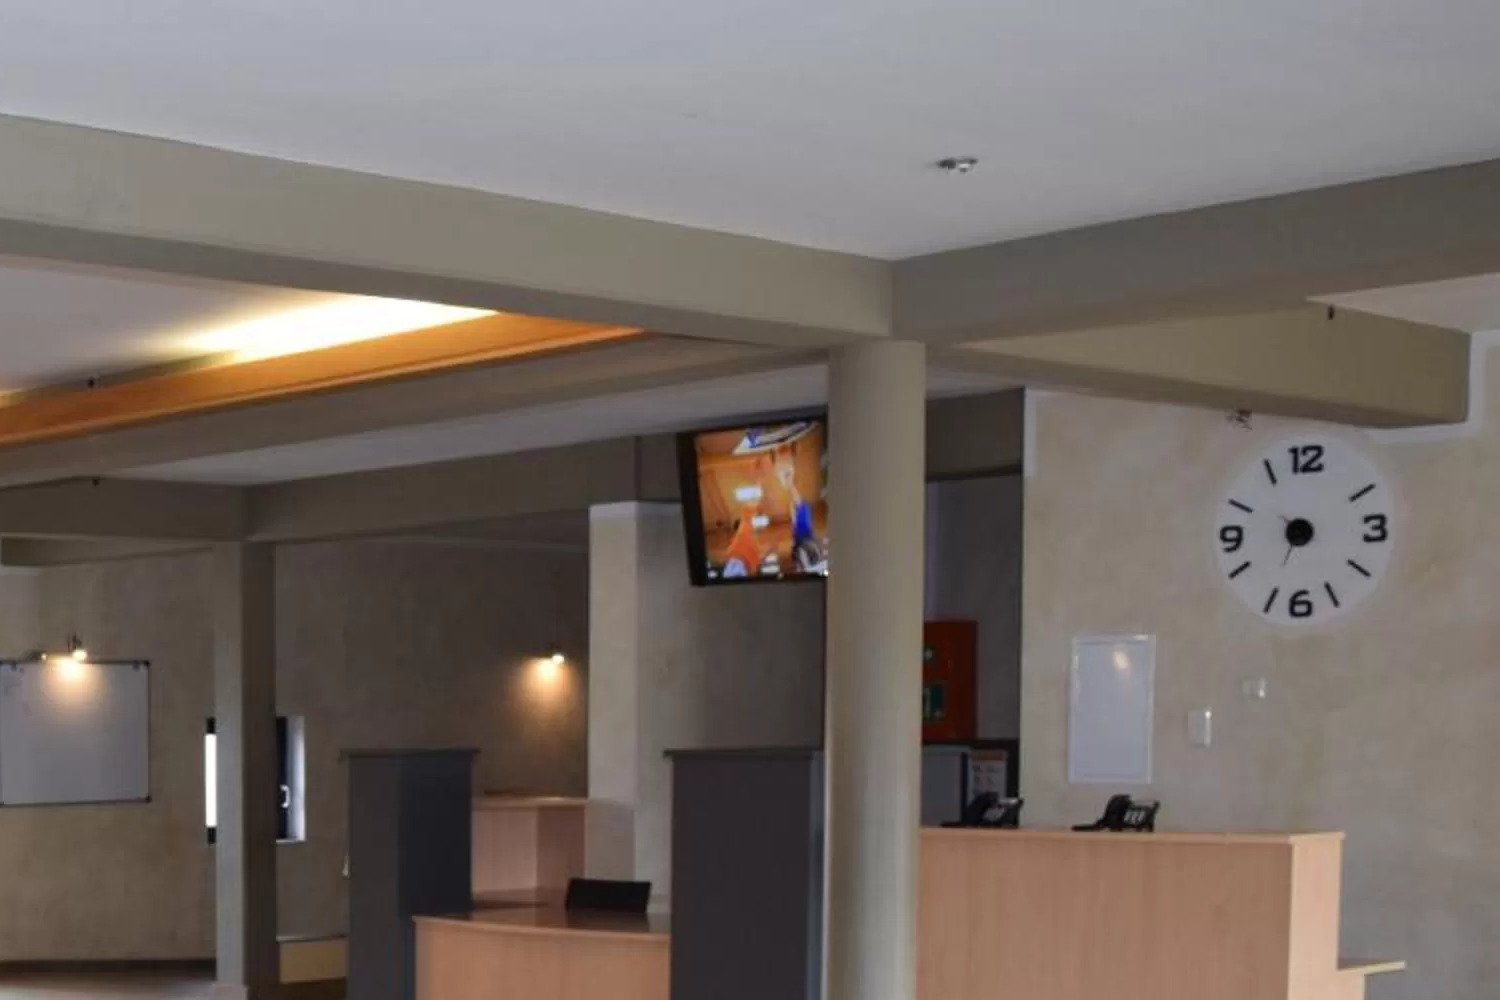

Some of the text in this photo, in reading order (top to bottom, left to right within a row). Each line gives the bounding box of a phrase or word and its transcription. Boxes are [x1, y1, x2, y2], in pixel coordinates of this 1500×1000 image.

[1288, 444, 1325, 475] 12
[1219, 525, 1244, 553] 9
[1362, 513, 1389, 543] 3
[1288, 589, 1314, 618] 6
